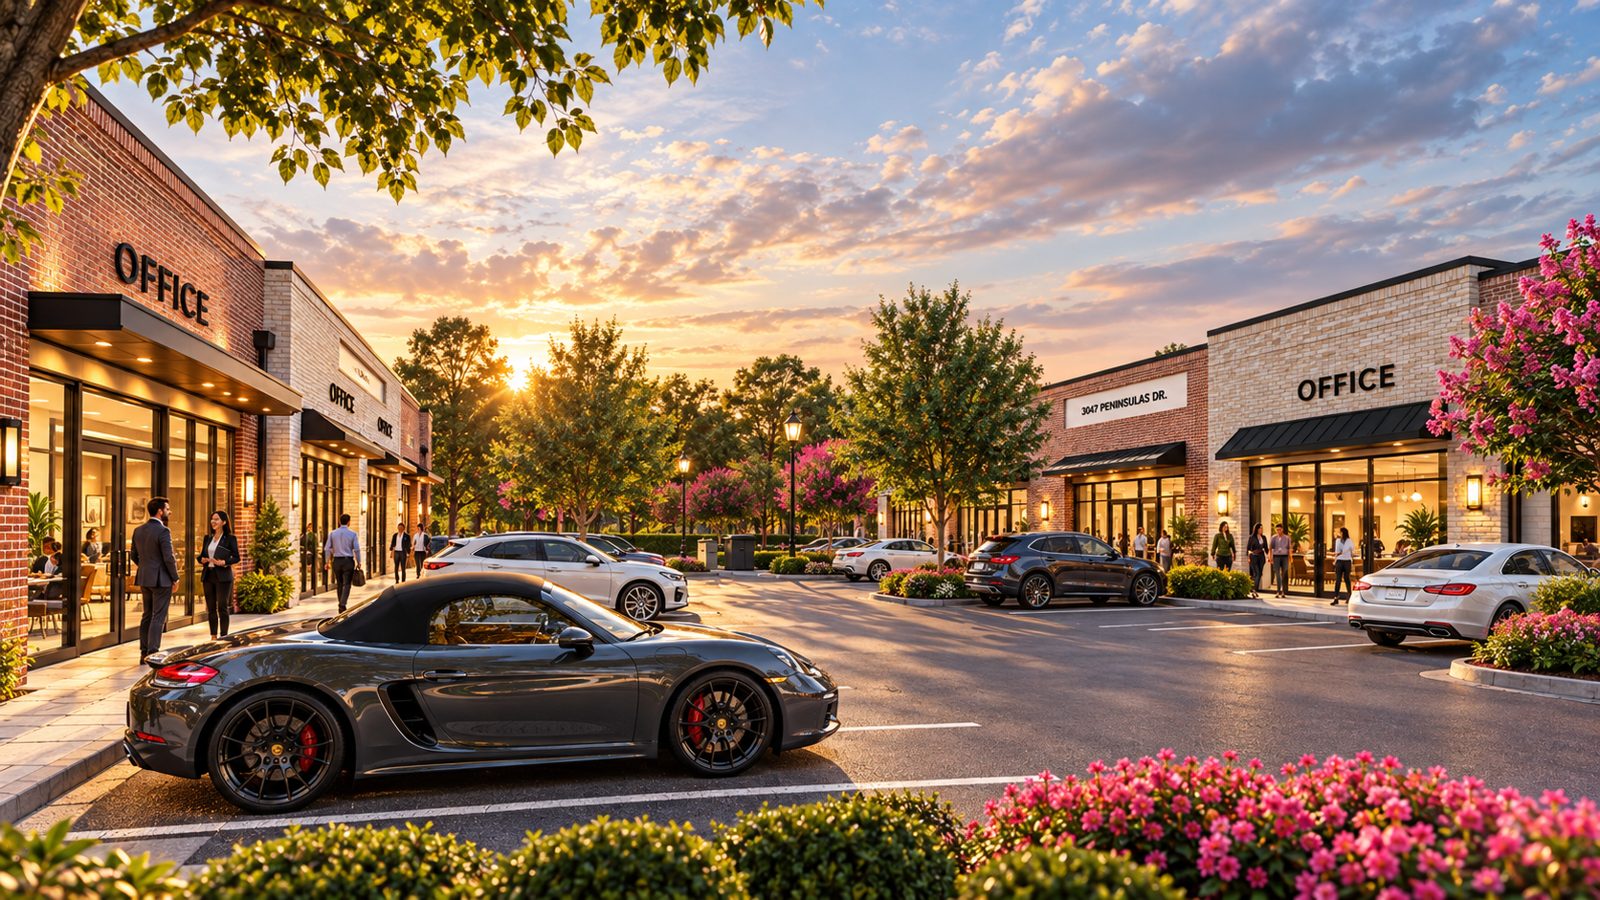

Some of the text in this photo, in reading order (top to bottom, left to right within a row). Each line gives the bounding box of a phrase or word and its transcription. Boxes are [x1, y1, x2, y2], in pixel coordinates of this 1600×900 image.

[115, 243, 209, 327] OFFICE
[329, 382, 355, 413] OFFICE
[1298, 363, 1395, 401] OFFICE
[1081, 390, 1167, 415] 3047 PENINSULAS DR.
